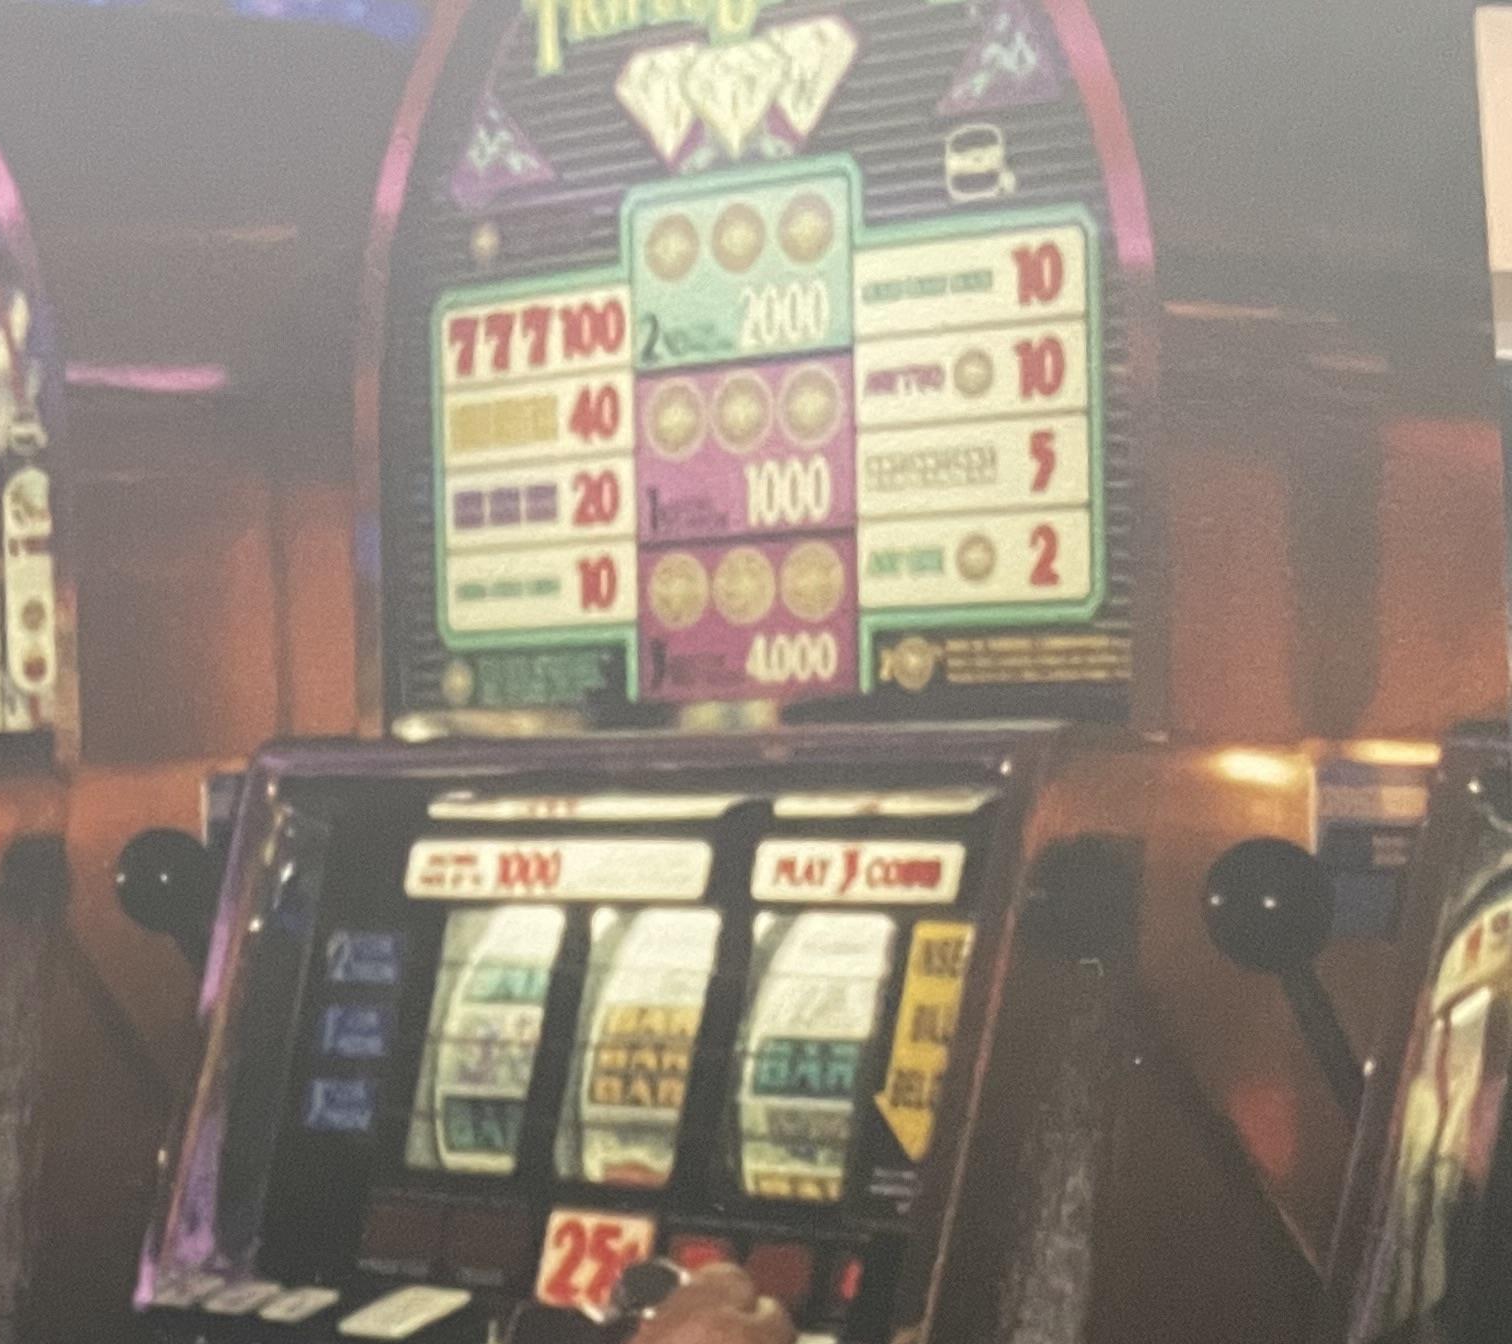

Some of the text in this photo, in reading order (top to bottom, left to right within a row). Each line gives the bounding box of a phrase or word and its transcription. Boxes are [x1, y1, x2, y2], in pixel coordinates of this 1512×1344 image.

[1011, 240, 1065, 306] 10
[448, 317, 480, 376] 7
[484, 311, 515, 371] 7
[521, 306, 552, 367] 7
[559, 300, 626, 359] 100
[739, 279, 831, 351] 2000
[1015, 336, 1066, 398] 10
[568, 384, 621, 441] 40
[744, 454, 832, 526] 1000
[1029, 428, 1057, 493] 5
[572, 469, 621, 527] 20
[576, 554, 617, 611] 10
[1028, 521, 1061, 588] 2
